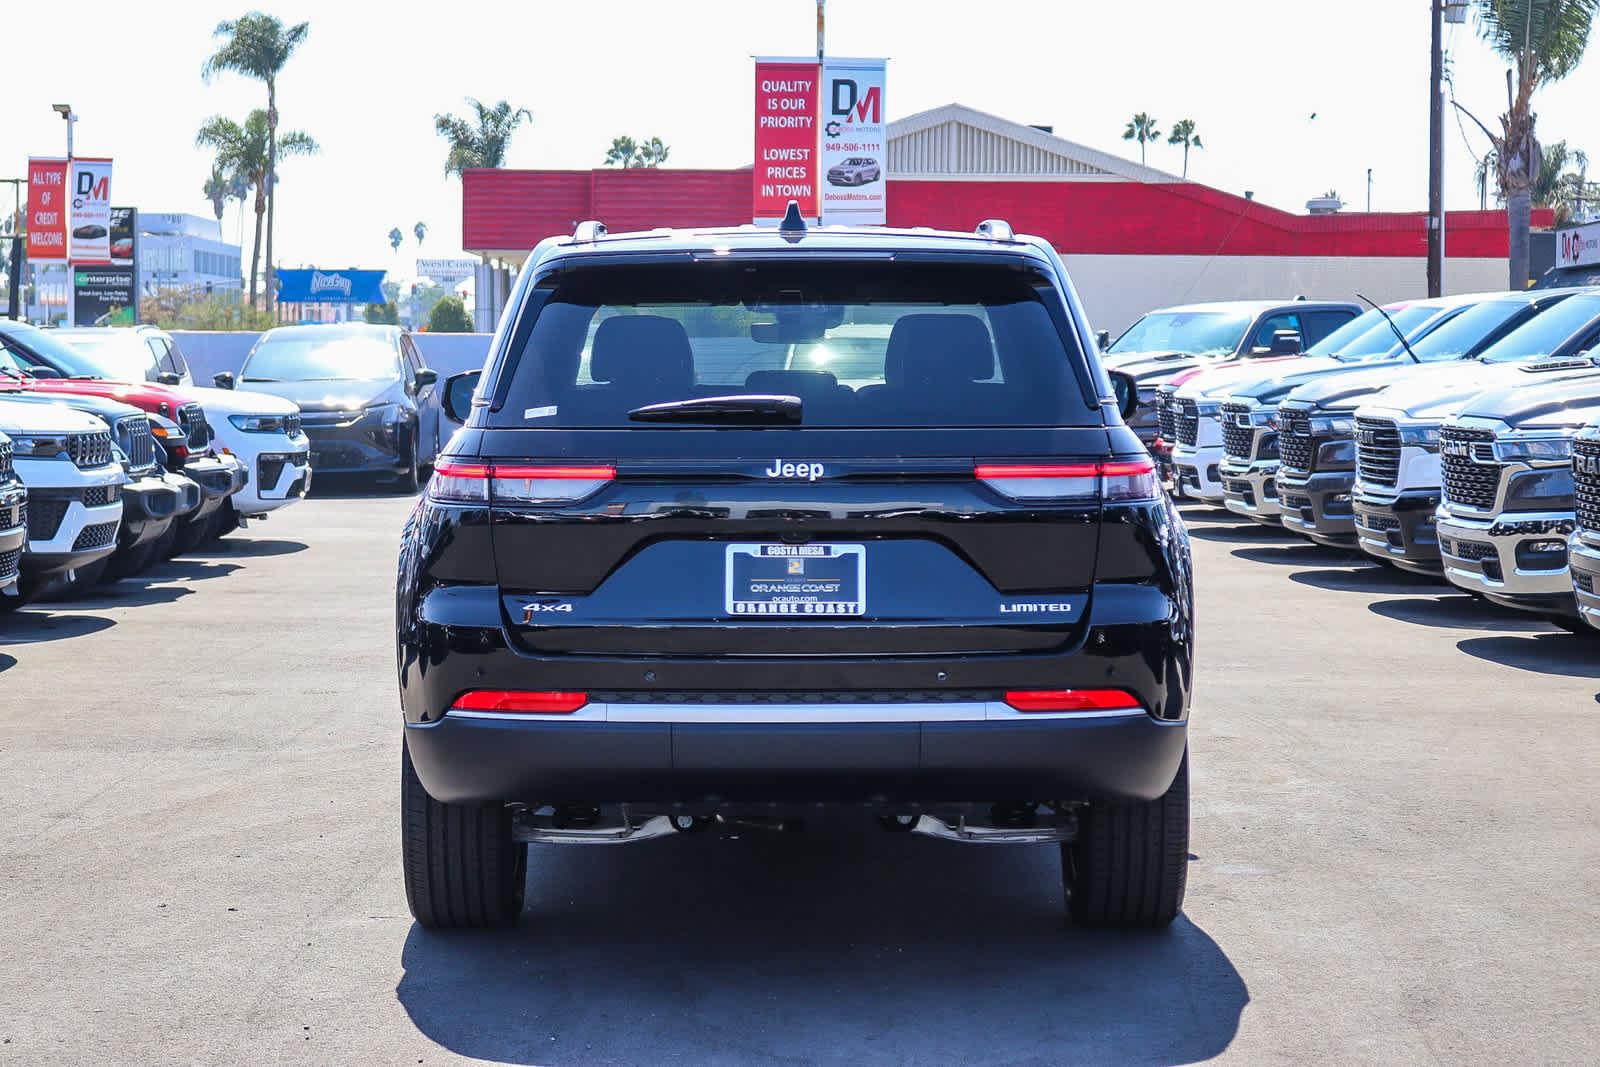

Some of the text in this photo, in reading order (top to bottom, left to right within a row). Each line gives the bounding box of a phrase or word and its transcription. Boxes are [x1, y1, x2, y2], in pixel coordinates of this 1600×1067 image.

[762, 81, 812, 93] QUALITY
[768, 99, 806, 110] IS OUR
[760, 117, 813, 128] PRIORITY
[764, 149, 810, 160] LOWEST
[768, 167, 806, 178] PRICES
[32, 172, 62, 185] ALL TYPE
[762, 185, 811, 197] IN TOWN
[41, 192, 51, 205] OF
[35, 212, 58, 224] CREDIT
[31, 232, 63, 246] WELCOME
[79, 275, 130, 286] enterprise
[1575, 454, 1600, 474] RA
[766, 459, 824, 481] Jeep
[767, 546, 825, 556] COSTA MESA
[750, 584, 840, 592] ORANGE COAST
[523, 603, 573, 612] 4x4
[736, 603, 856, 613] ORANGE COAST
[1000, 604, 1072, 613] LIMITED
